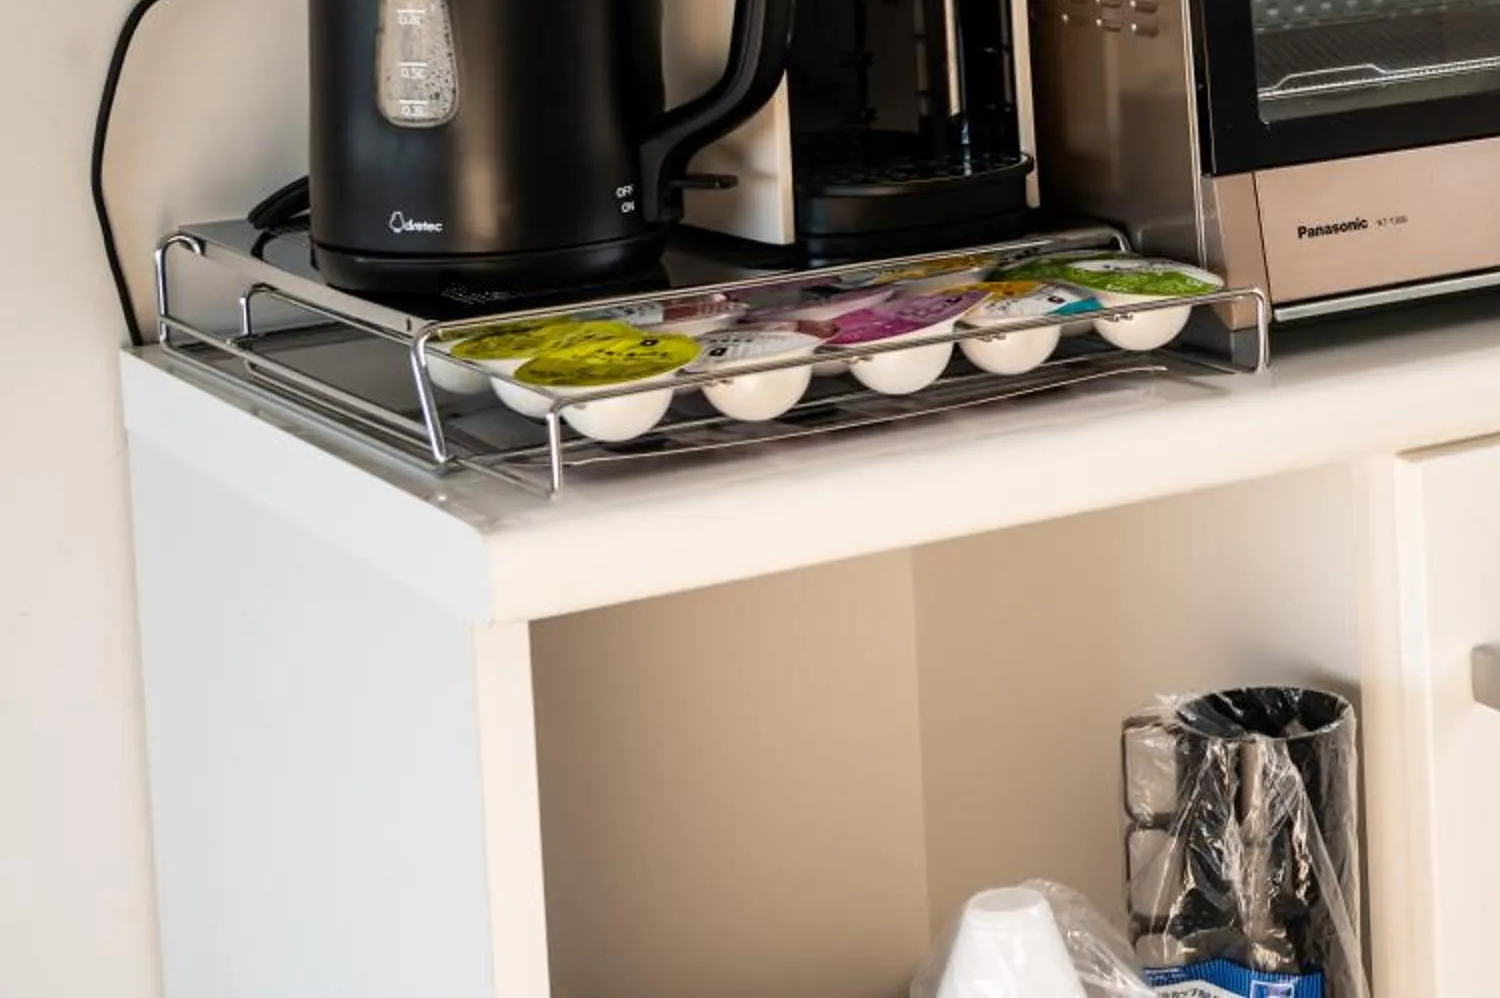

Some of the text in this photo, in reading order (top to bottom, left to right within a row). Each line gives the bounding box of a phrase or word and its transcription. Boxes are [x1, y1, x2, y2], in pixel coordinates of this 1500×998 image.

[615, 184, 634, 198] OFF
[621, 201, 635, 213] ON
[403, 218, 443, 233] dretec
[1297, 217, 1368, 239] Panasonic
